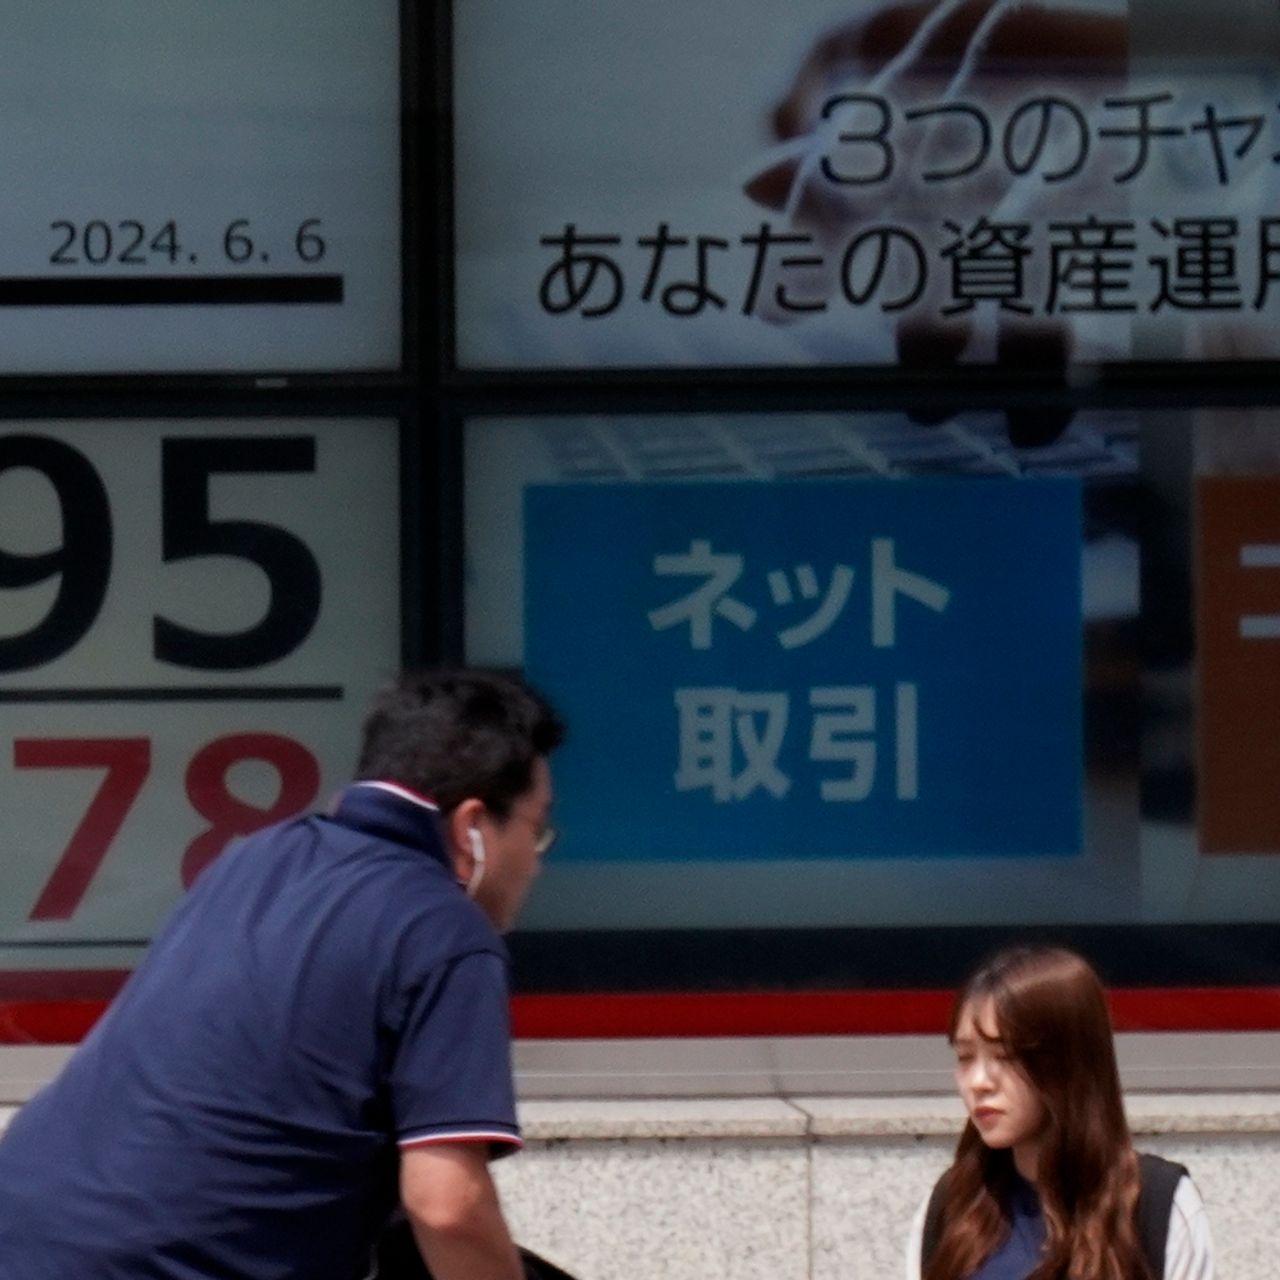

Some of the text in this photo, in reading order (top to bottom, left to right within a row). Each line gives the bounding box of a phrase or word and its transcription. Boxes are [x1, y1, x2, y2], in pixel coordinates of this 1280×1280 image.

[819, 92, 1280, 187] 3つのチャ
[648, 537, 951, 650] ネット
[673, 682, 919, 802] 取引
